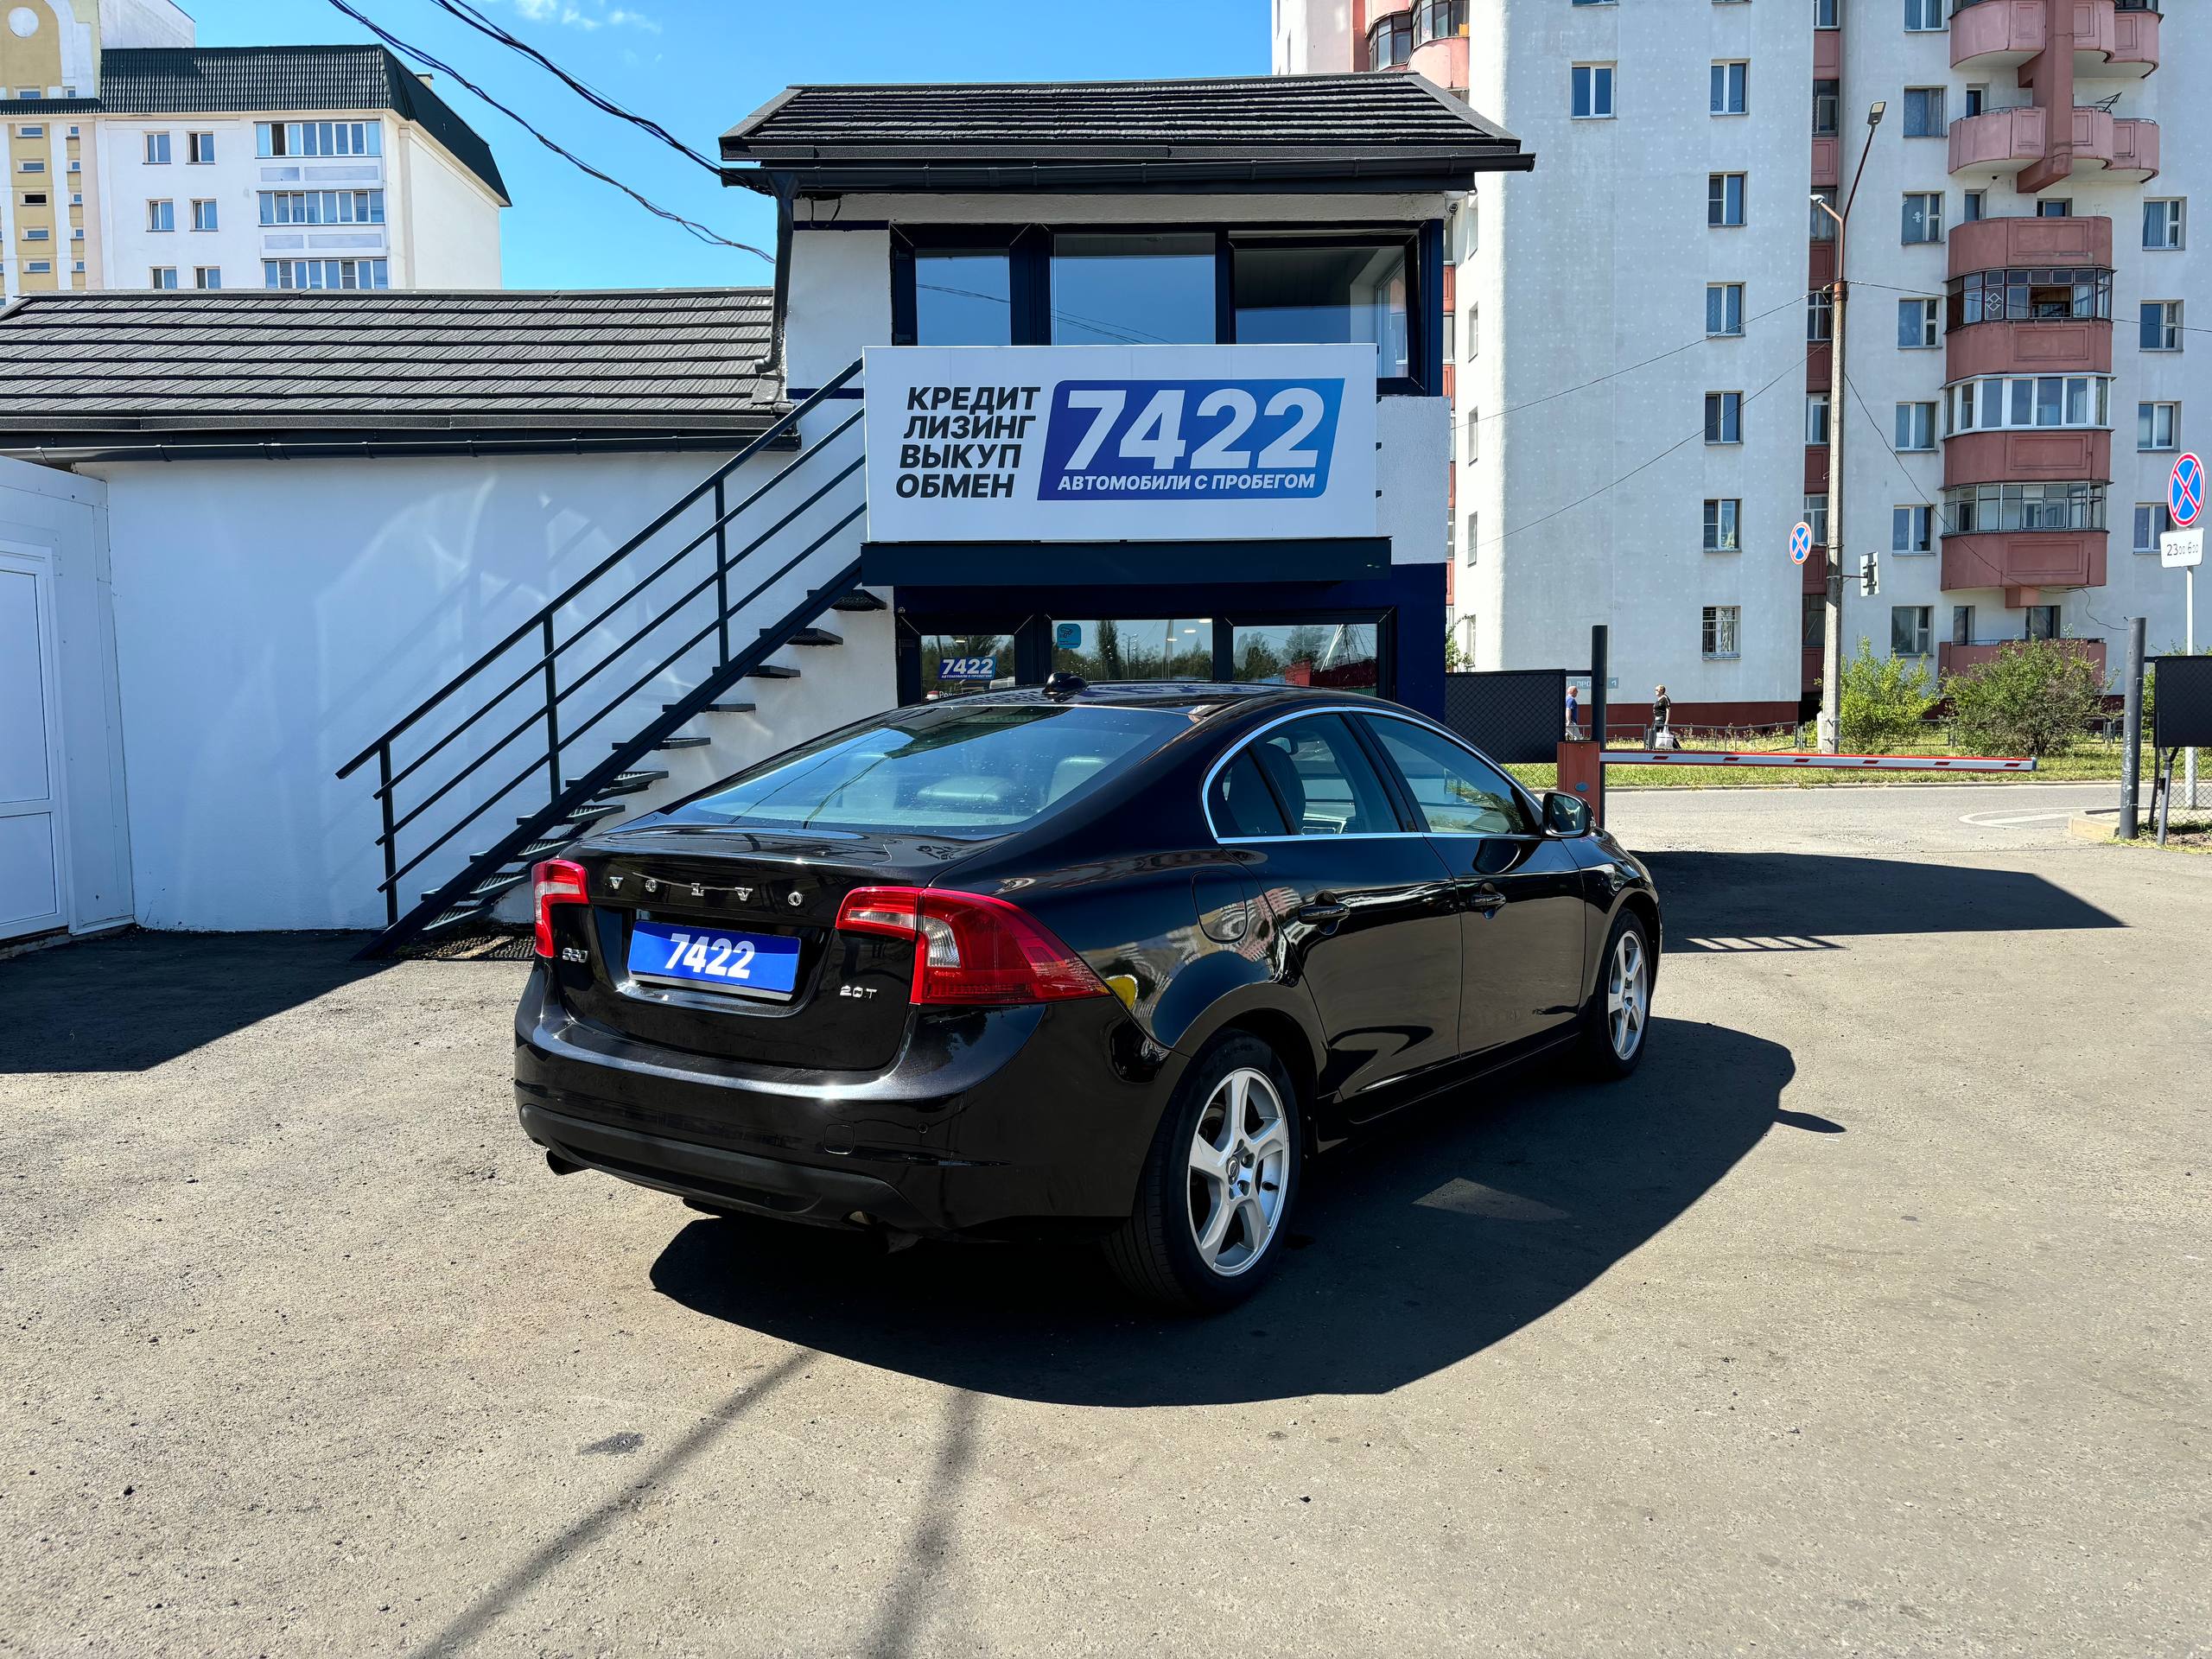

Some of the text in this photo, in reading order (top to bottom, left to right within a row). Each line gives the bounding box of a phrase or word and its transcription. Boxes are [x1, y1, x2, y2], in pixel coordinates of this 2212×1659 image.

[906, 386, 1041, 416] КРЕДИТ
[903, 415, 1037, 440] ЛИЗИНГ
[1064, 387, 1325, 470] 7422
[899, 443, 1022, 469] ВЫКУП
[895, 474, 1015, 499] ОБМЕН
[1057, 474, 1316, 491] АВТОМОБИЛИ С ПРОБЕГОМ
[943, 658, 994, 675] 7422
[608, 875, 804, 906] VOLVO
[664, 932, 755, 980] 7422
